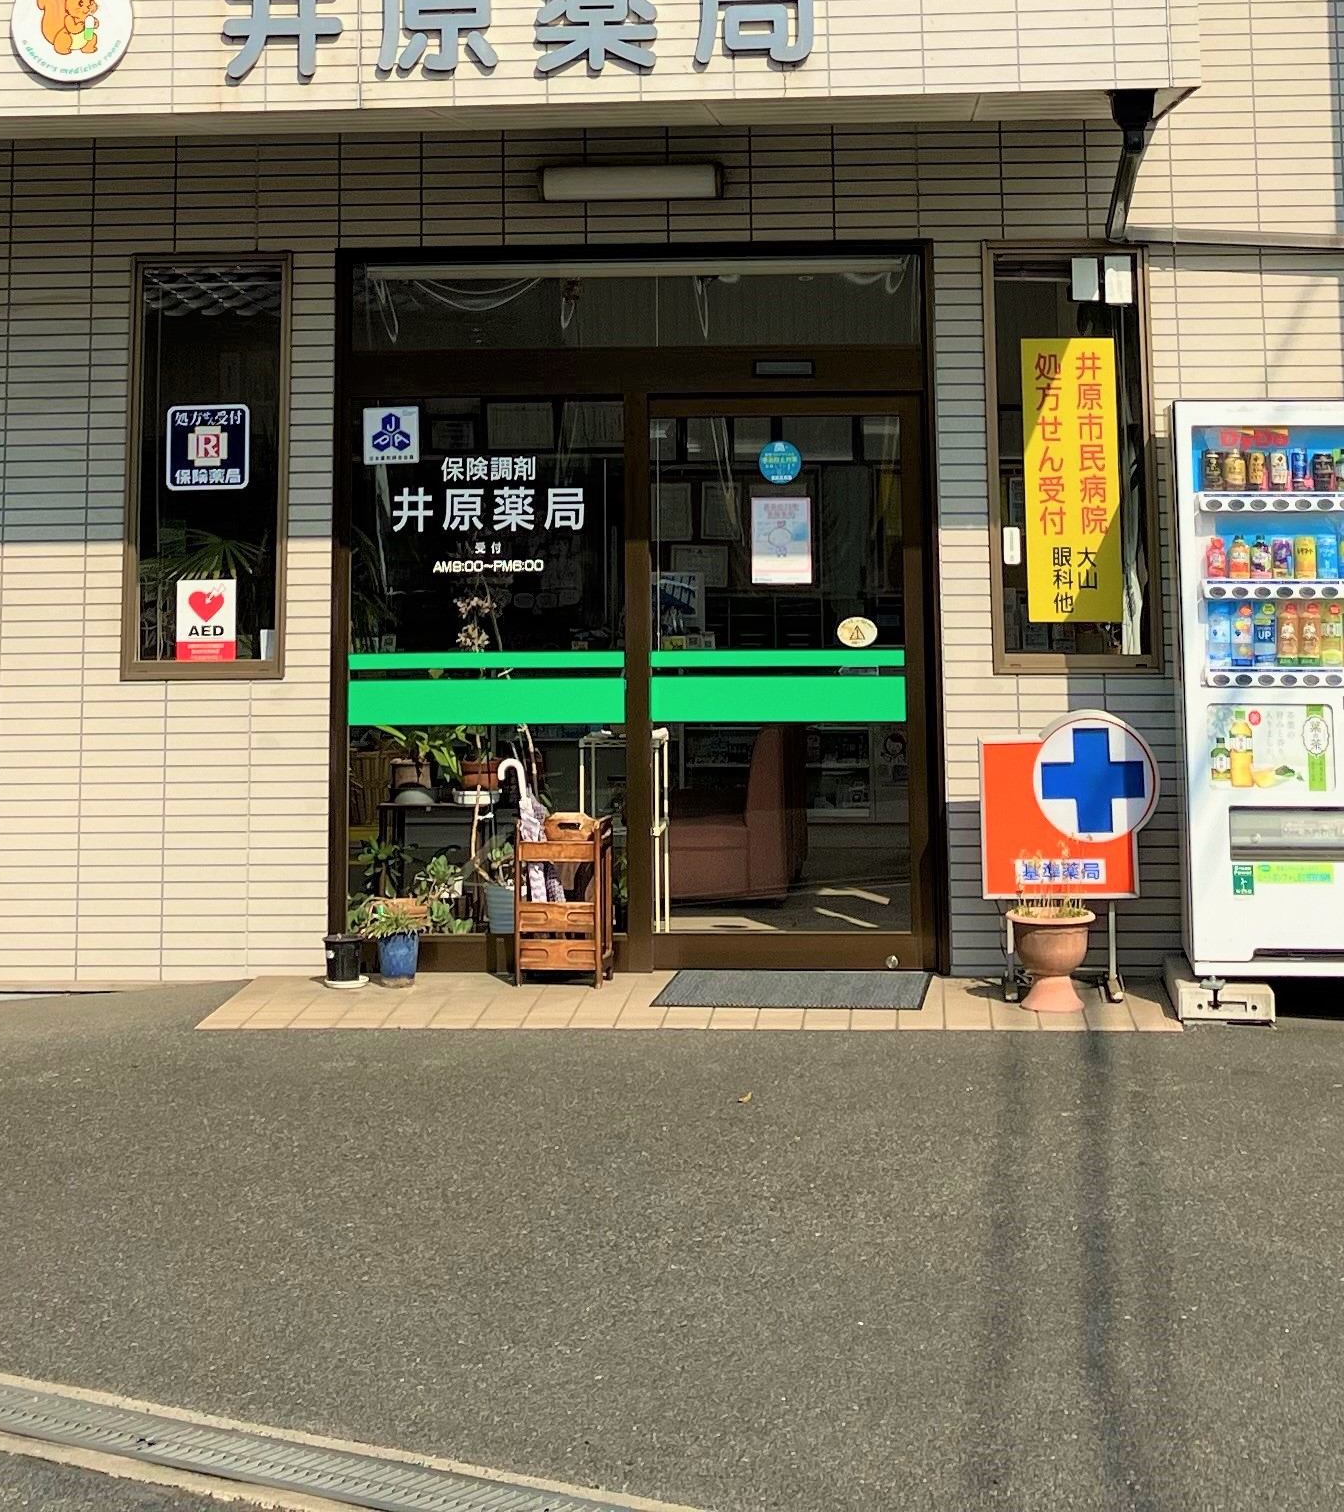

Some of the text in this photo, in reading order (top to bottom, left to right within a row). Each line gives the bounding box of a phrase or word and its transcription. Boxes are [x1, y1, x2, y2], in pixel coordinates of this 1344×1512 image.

[175, 410, 242, 426] 処方せん受付
[1034, 352, 1066, 536] 処方せん受付
[1075, 351, 1109, 535] 井原市民病院
[175, 468, 241, 484] 保険薬局
[441, 456, 536, 482] 保険調剤
[392, 486, 585, 533] 井原薬局
[475, 542, 502, 555] 受付
[1052, 547, 1074, 614] 眼科他
[1076, 547, 1098, 590] 大山
[188, 625, 224, 637] AED
